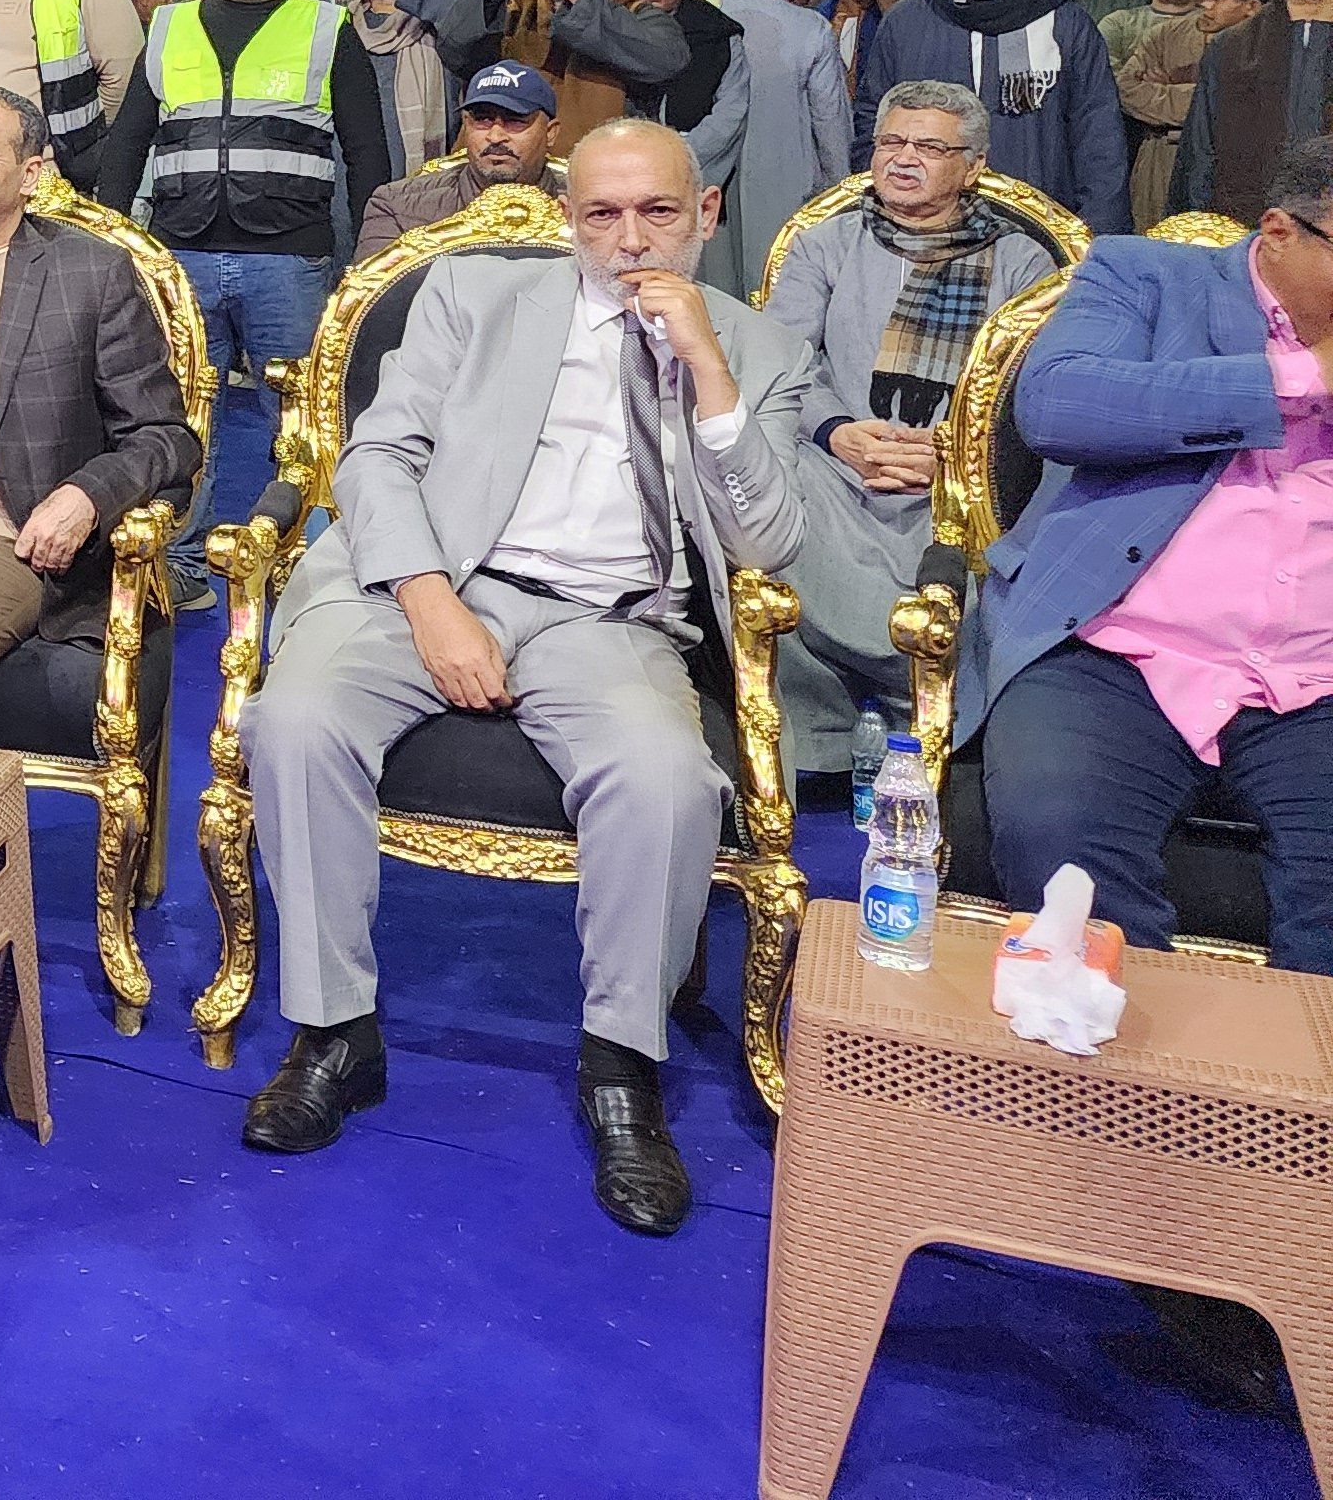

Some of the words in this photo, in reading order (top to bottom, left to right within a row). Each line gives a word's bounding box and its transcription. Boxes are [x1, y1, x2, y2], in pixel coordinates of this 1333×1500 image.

[476, 75, 511, 90] PUMA
[853, 793, 875, 810] SIS
[867, 897, 912, 929] ISIS
